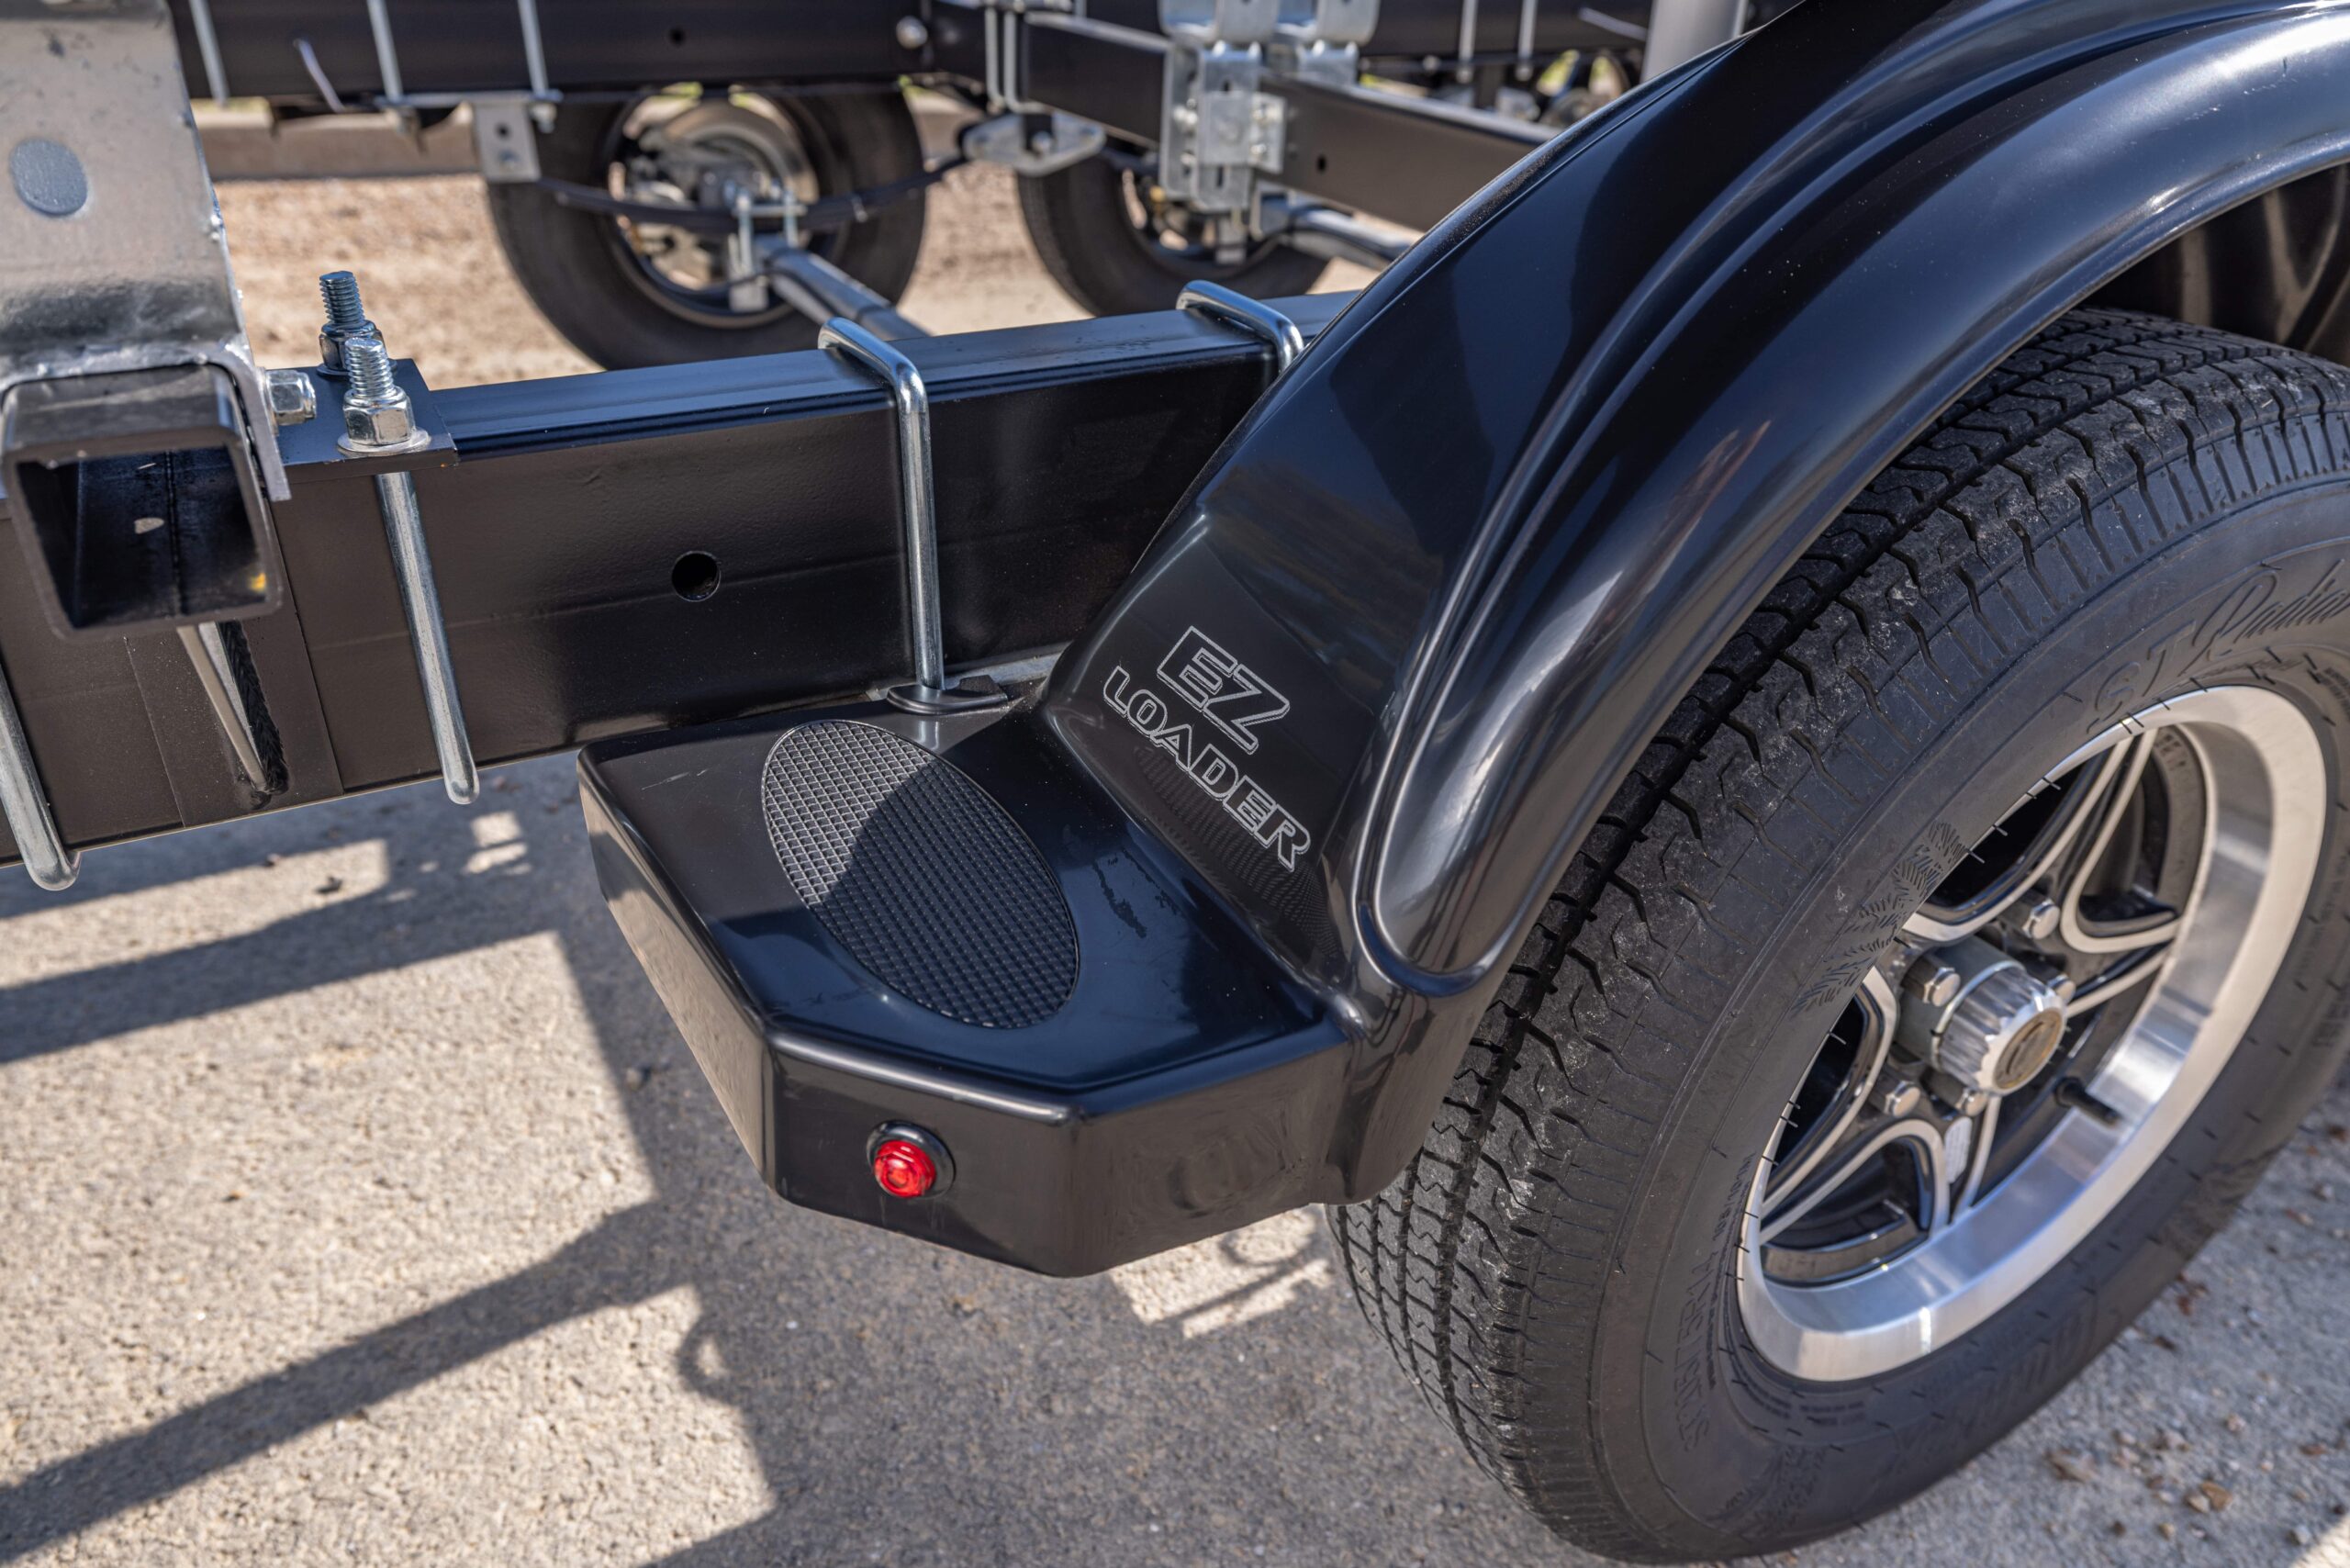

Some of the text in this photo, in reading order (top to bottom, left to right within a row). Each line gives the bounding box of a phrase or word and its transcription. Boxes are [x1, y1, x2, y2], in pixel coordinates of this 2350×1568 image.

[2177, 558, 2350, 678] Radia
[1157, 625, 1291, 756] EZ
[1103, 666, 1312, 872] LOADER
